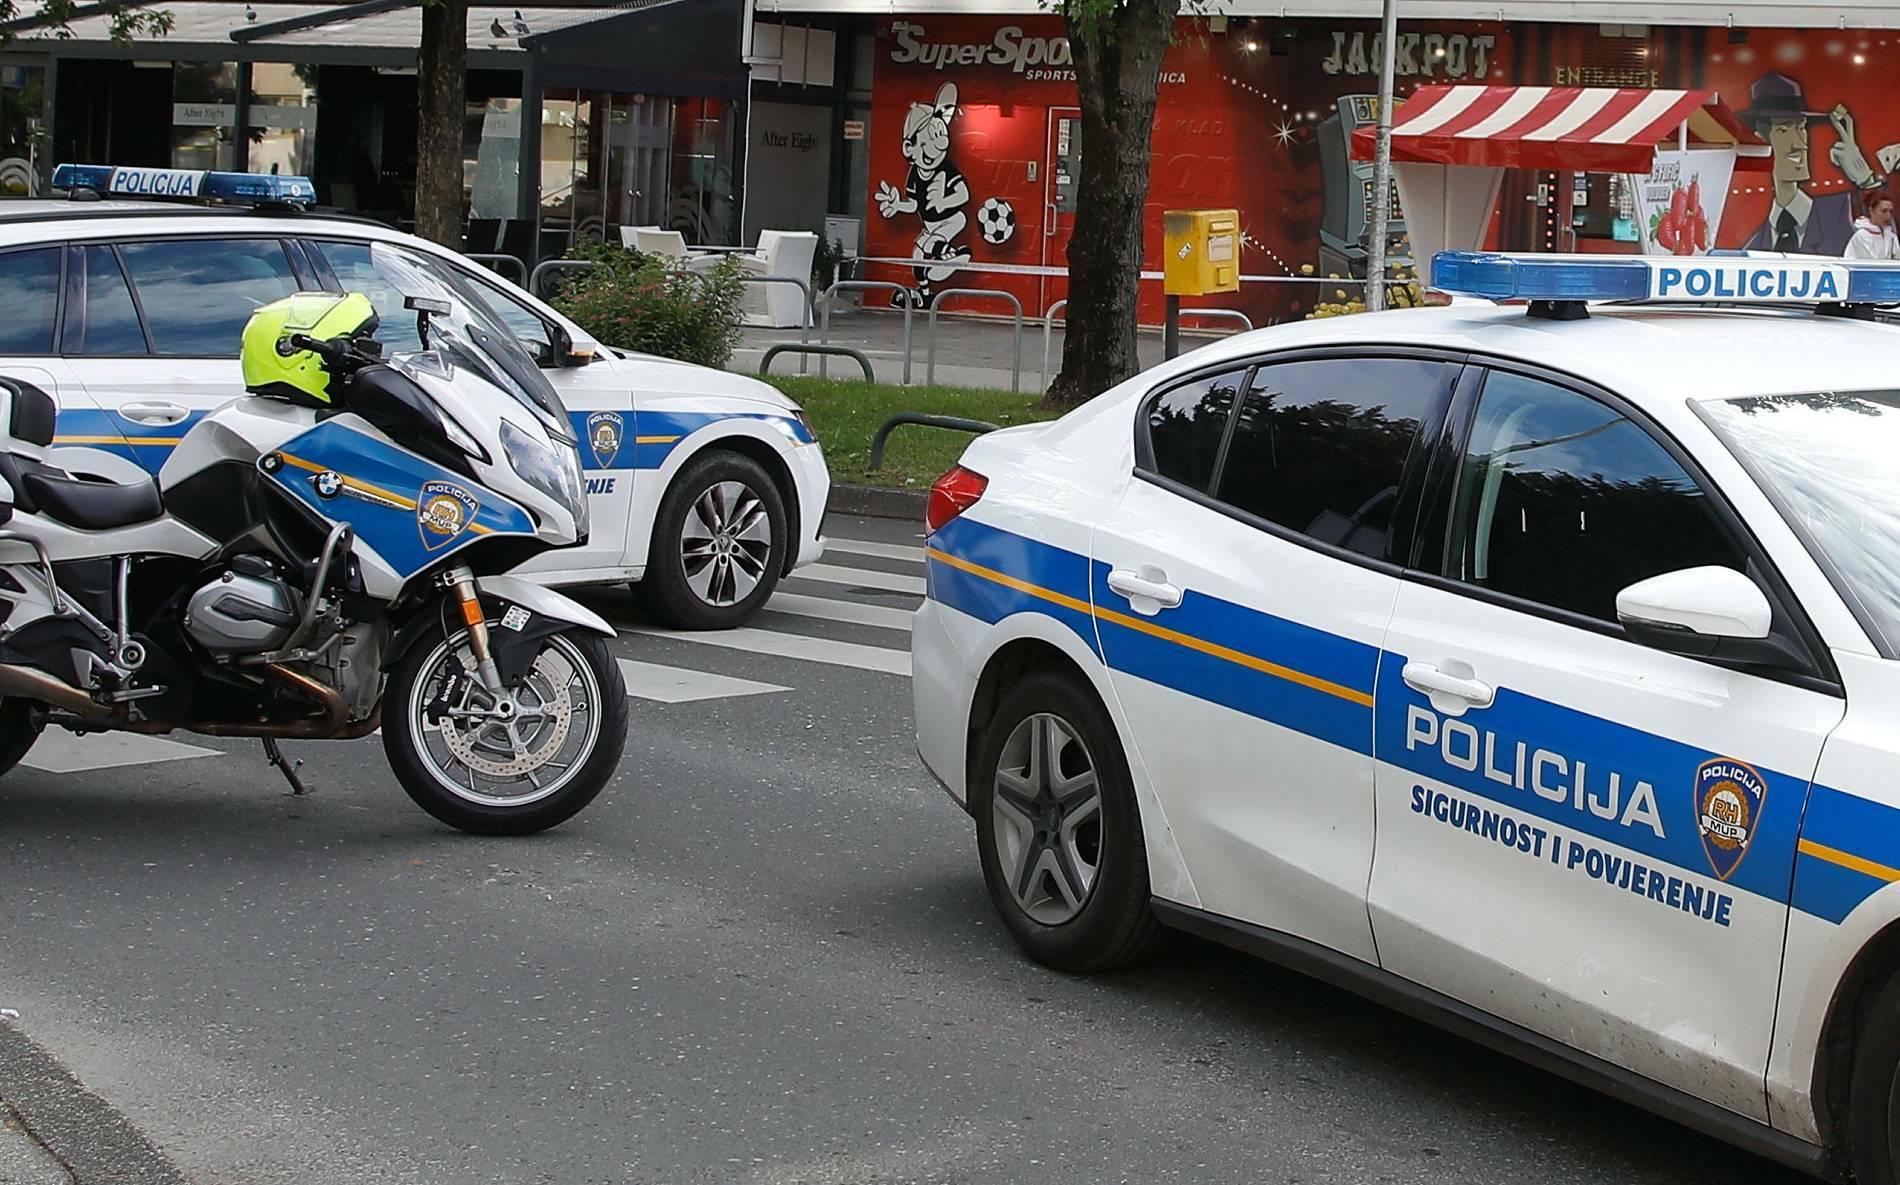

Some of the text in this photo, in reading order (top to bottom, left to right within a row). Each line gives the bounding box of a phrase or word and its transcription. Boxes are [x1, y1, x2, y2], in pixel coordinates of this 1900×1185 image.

[890, 25, 1074, 72] SuperSpo
[1025, 69, 1077, 82] SPORTS
[1556, 66, 1660, 88] ENTRANCE
[761, 130, 789, 147] After
[114, 171, 194, 196] POLICIJA
[1658, 267, 1838, 298] POLICIJA
[590, 413, 622, 425] POLICIJA
[428, 484, 477, 511] POLICIJA
[430, 515, 452, 529] MUP
[1406, 704, 1666, 839] POLICIJA
[1702, 765, 1762, 800] POLICIJA
[1712, 798, 1739, 824] RH
[1710, 821, 1738, 837] MUP
[1411, 784, 1733, 927] SIGURNOST I POVJERENJE
